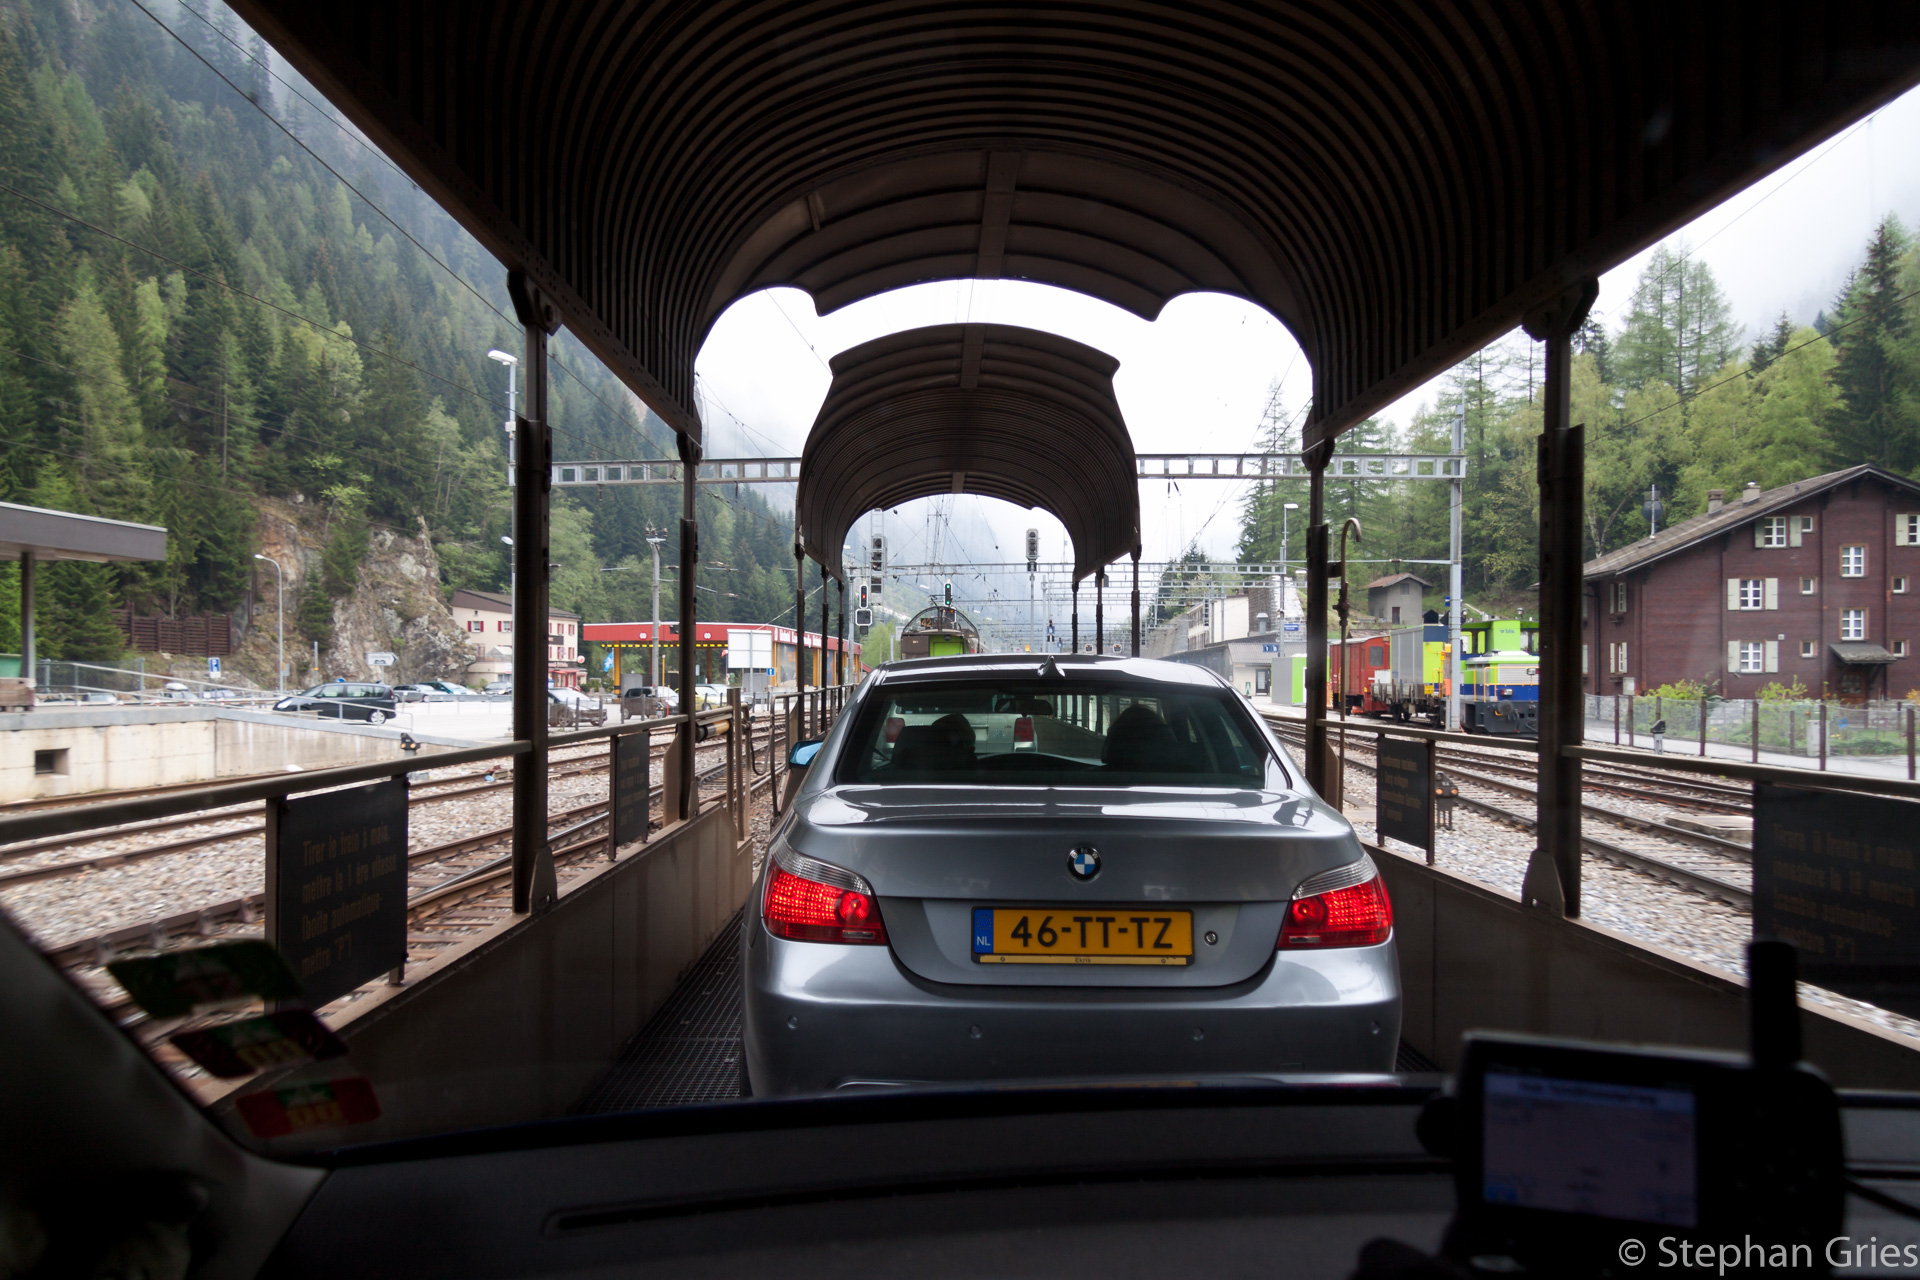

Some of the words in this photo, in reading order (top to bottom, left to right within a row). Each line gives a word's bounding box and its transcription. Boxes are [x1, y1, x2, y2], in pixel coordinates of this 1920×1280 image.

[921, 618, 932, 627] 42
[303, 840, 326, 867] Tirer
[328, 834, 337, 859] le
[340, 829, 360, 855] frein
[302, 874, 332, 905] mettre
[336, 867, 343, 892] la
[371, 853, 397, 879] vitesse
[977, 936, 991, 946] NL
[1011, 916, 1173, 949] 46-TT-TZ
[301, 947, 332, 979] mettre
